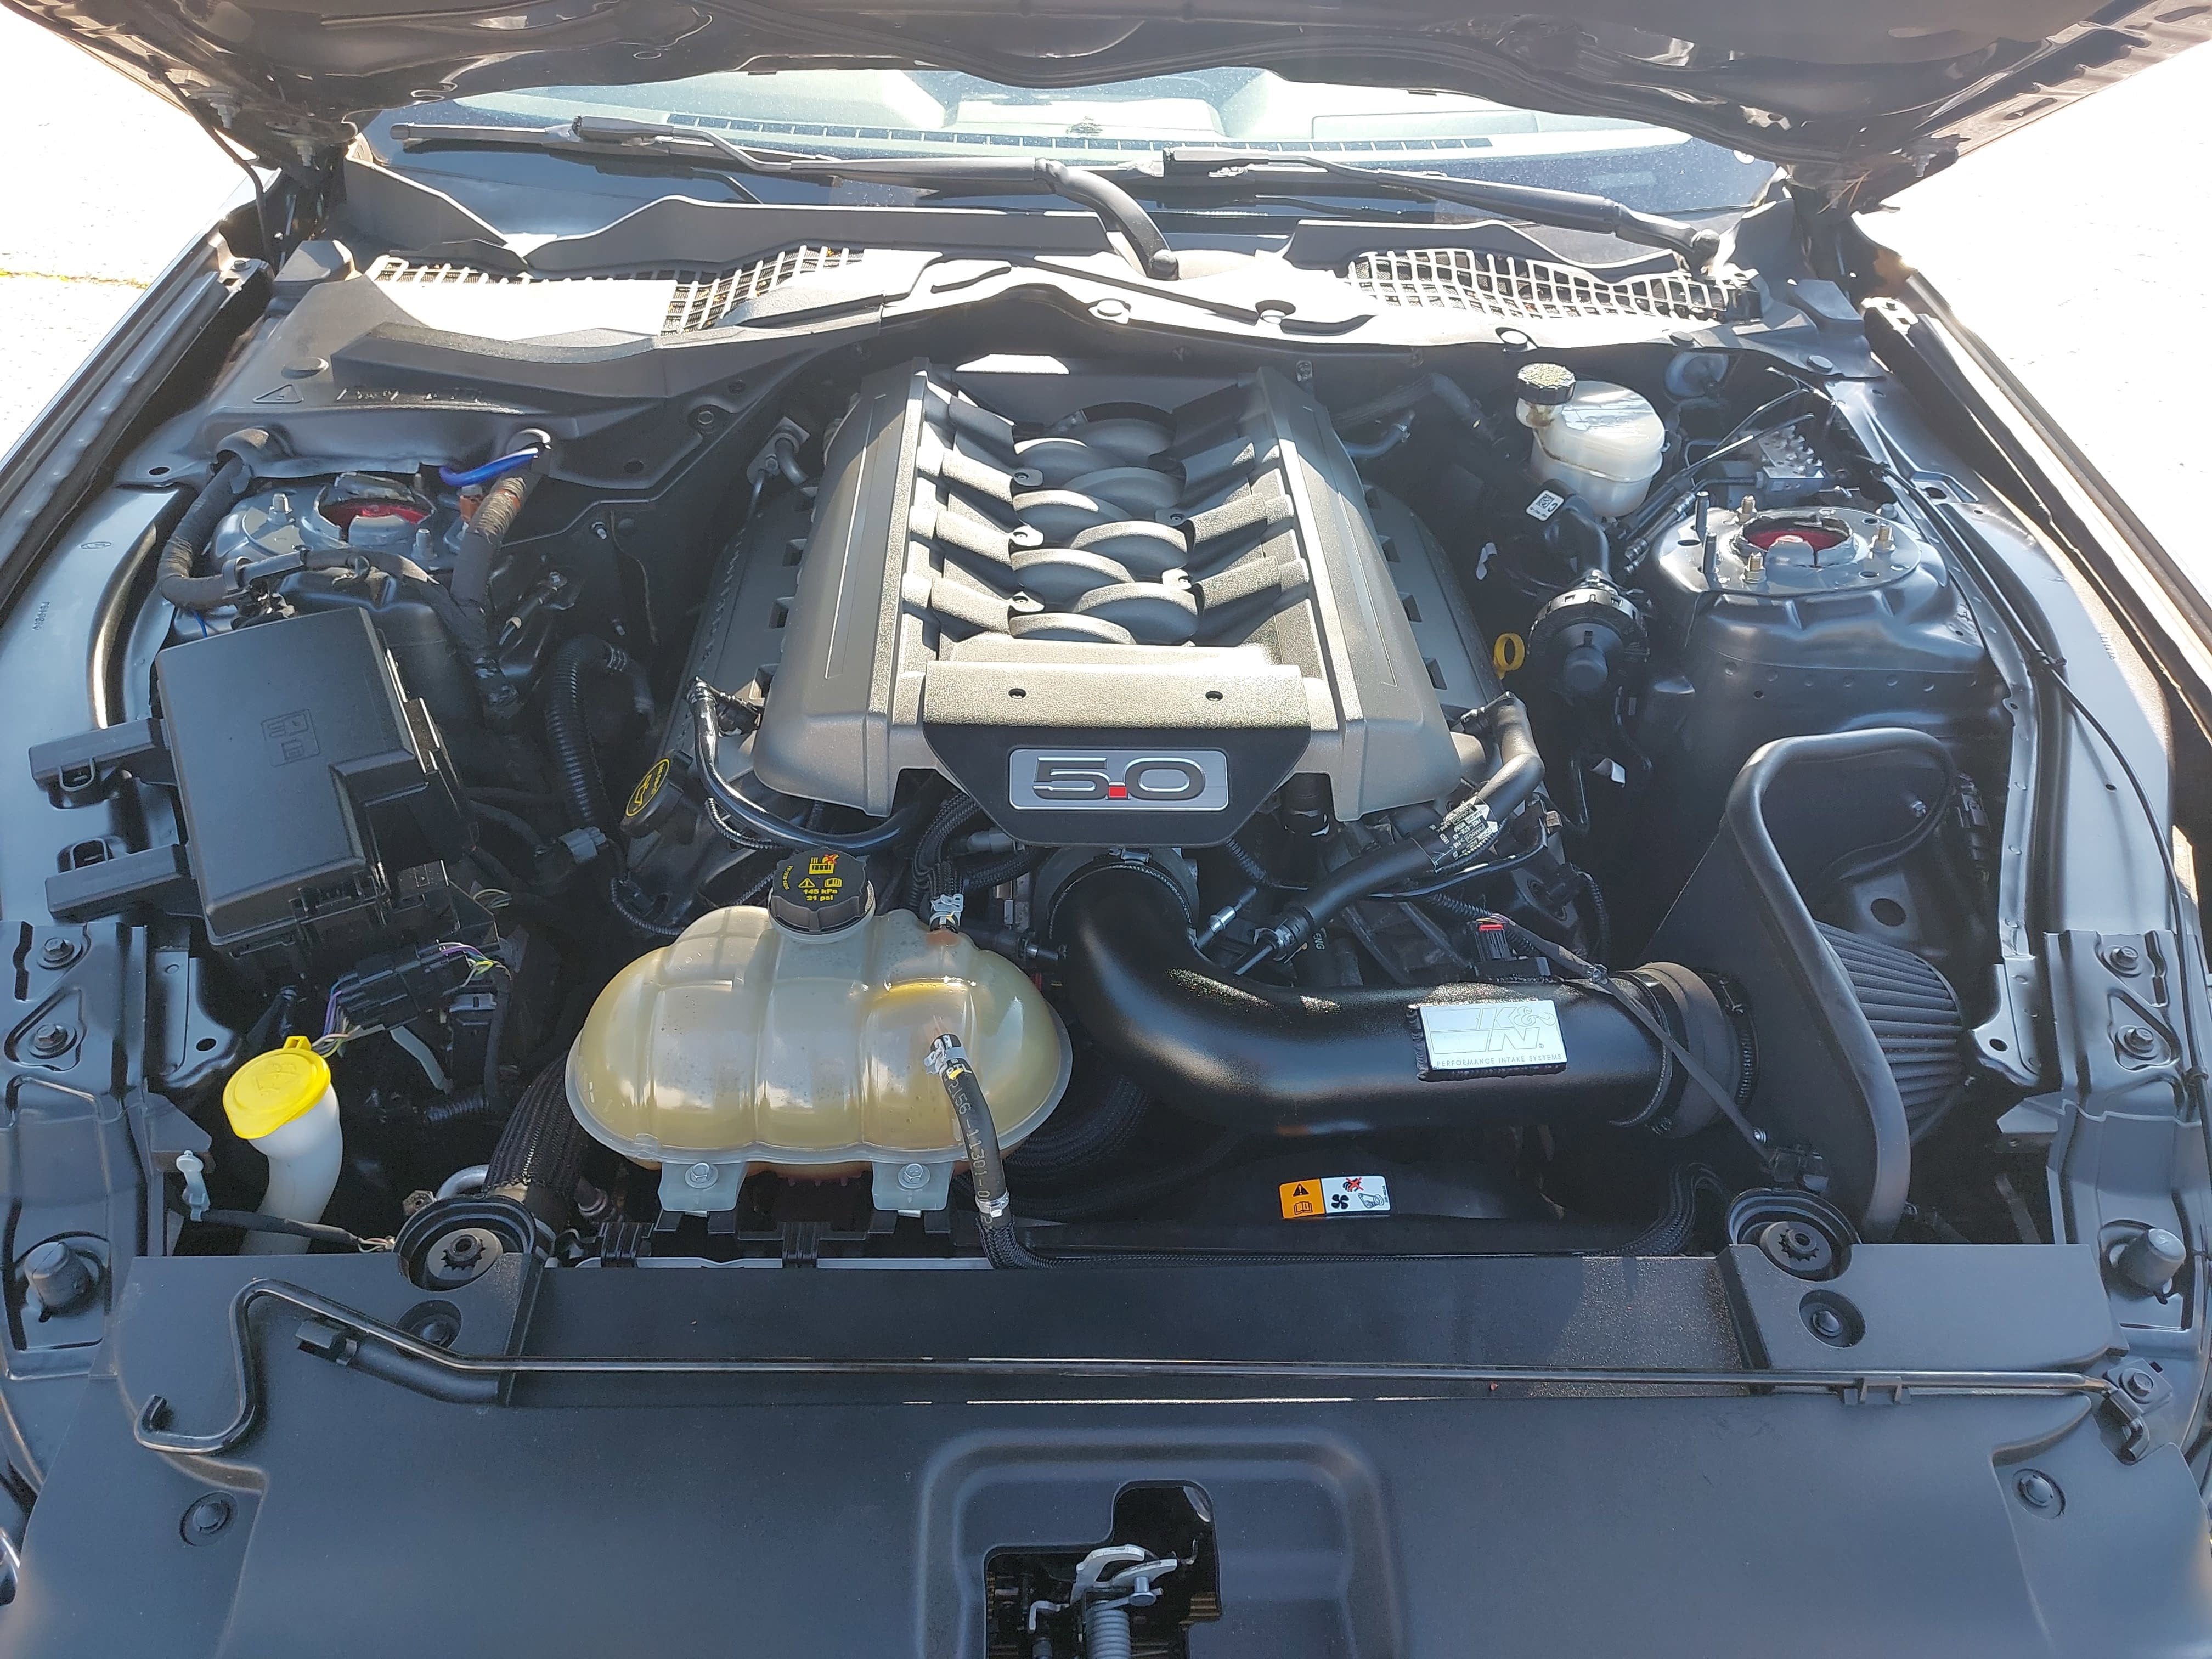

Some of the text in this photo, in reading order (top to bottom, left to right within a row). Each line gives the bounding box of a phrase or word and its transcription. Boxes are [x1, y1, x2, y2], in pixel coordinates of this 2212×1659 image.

[1032, 757, 1206, 800] 5.0
[1437, 1058, 1495, 1067] PERFORMANCE
[1529, 1053, 1562, 1062] SYSTEMS
